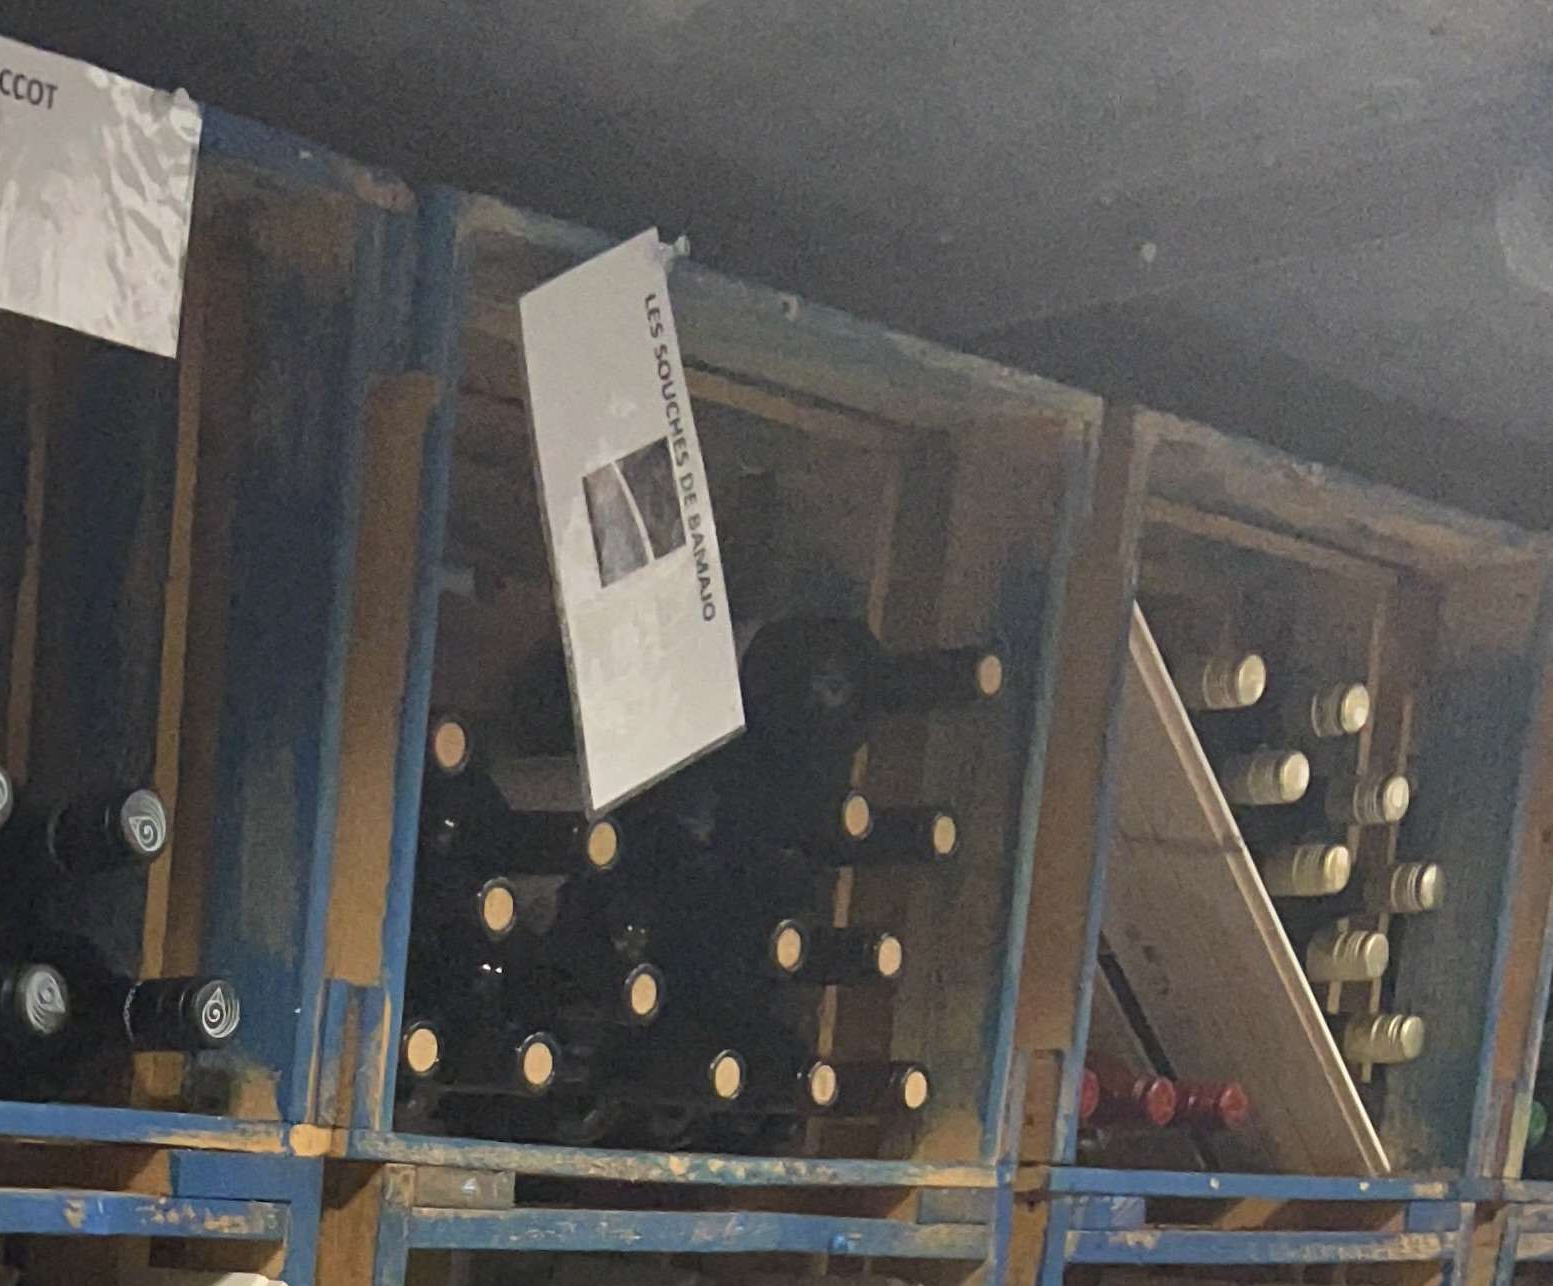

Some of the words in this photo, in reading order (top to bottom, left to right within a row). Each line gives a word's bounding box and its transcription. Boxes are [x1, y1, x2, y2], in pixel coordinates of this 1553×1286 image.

[643, 292, 664, 338] LES
[653, 344, 691, 468] SOUCHES
[680, 474, 697, 507] DE
[687, 513, 717, 622] BAMAJO
